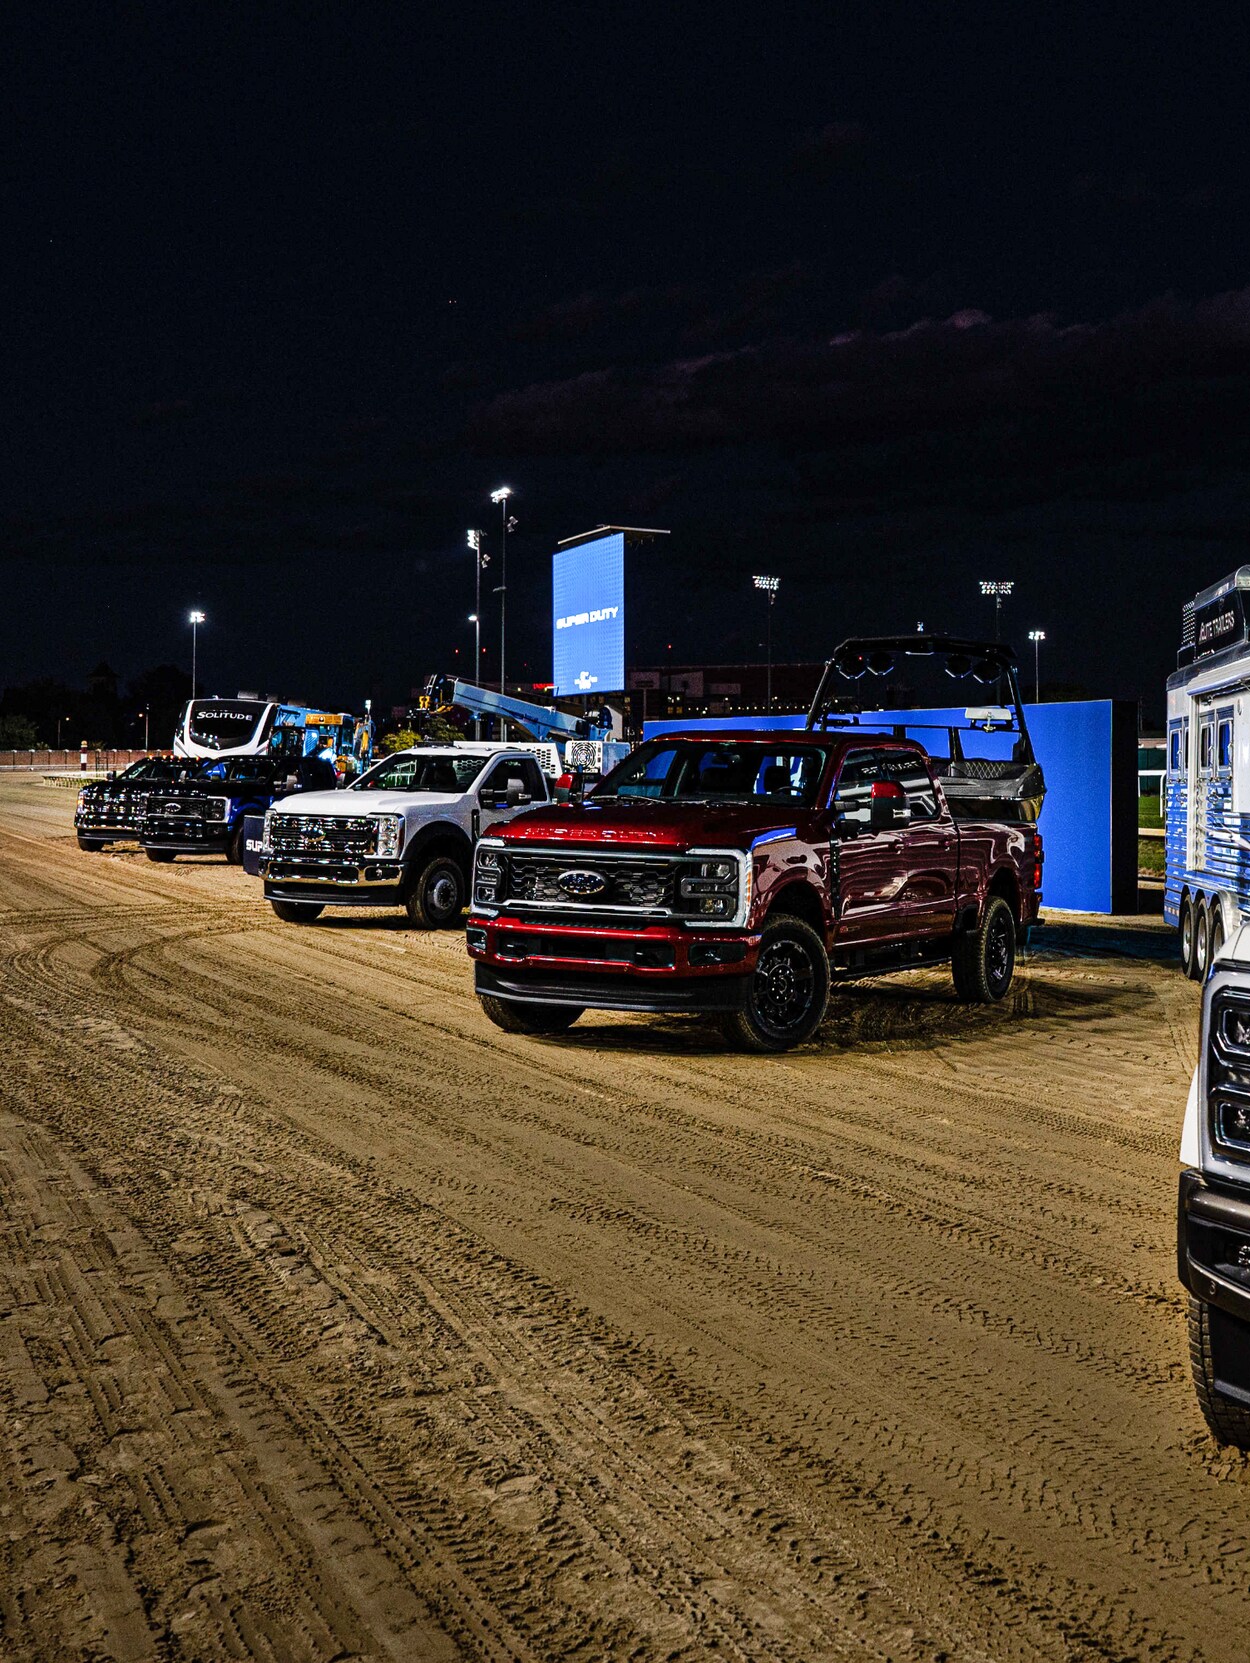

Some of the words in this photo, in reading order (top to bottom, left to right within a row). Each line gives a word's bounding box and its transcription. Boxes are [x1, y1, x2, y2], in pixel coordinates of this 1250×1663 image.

[557, 613, 589, 628] SUPER
[590, 607, 618, 622] DUTY
[196, 711, 253, 721] SOLITUDE
[245, 839, 263, 852] SUP
